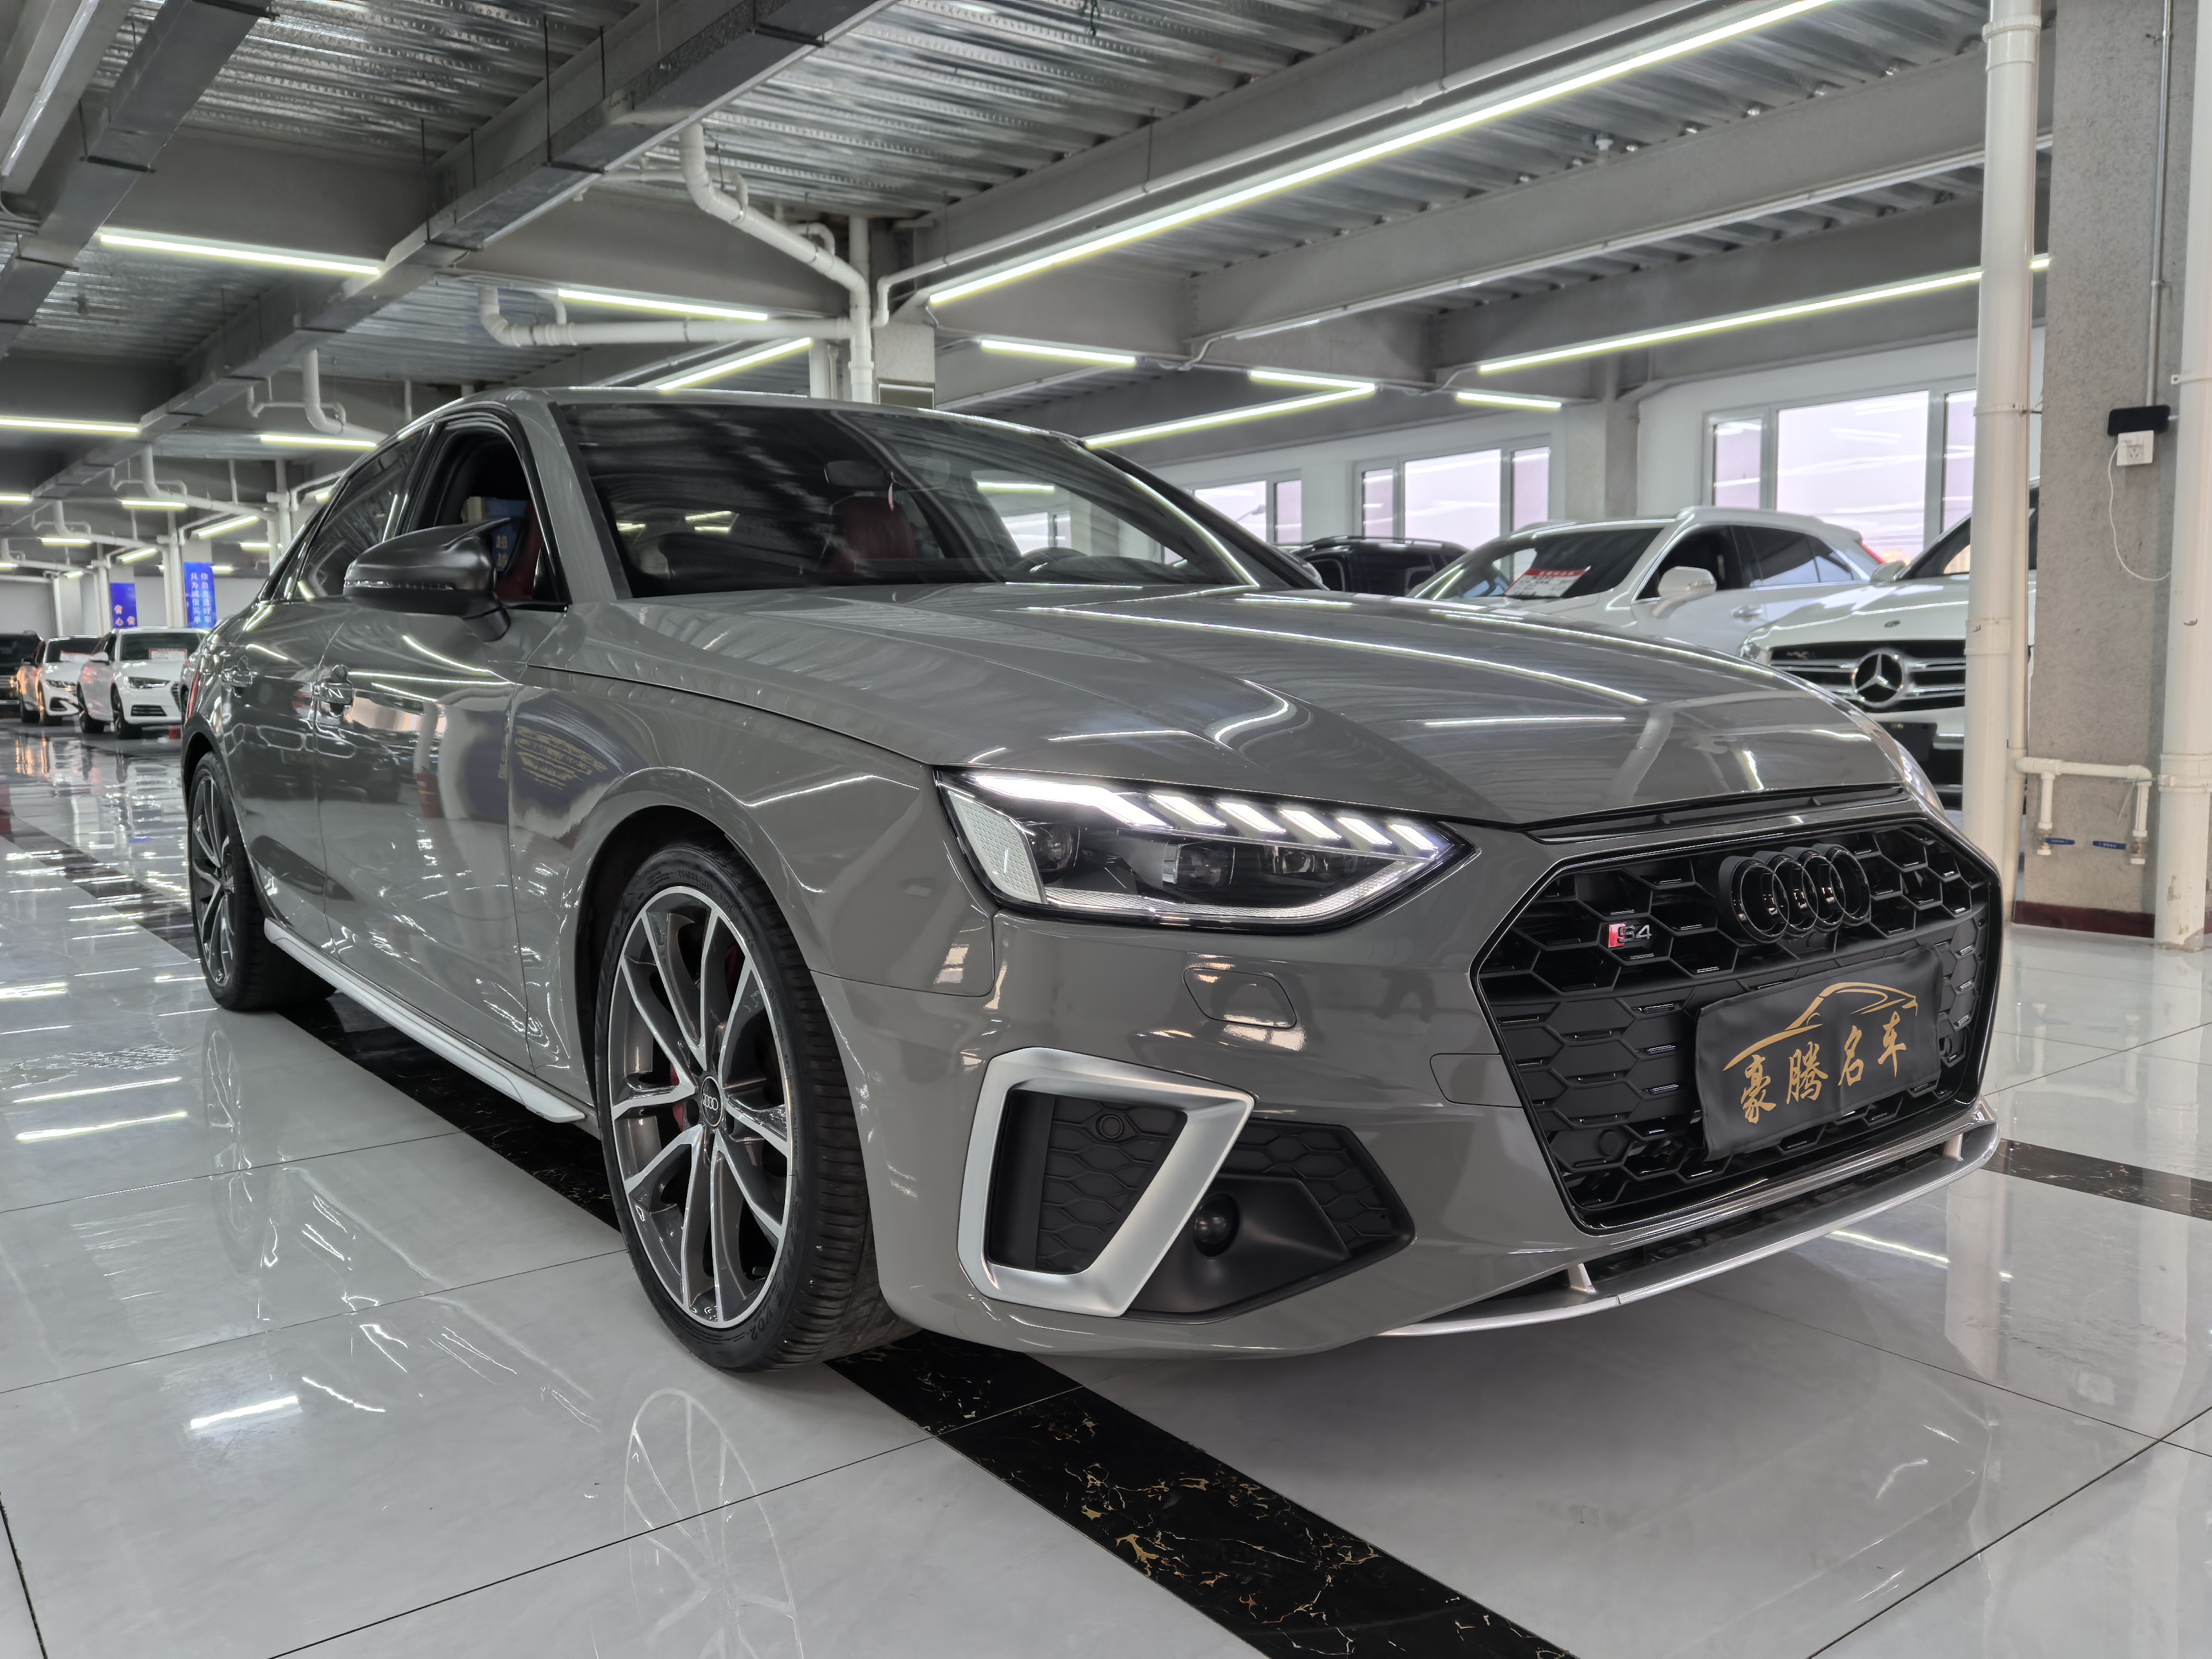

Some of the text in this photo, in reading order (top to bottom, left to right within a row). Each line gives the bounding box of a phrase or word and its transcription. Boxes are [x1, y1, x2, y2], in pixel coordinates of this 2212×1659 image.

[1618, 925, 1652, 943] S4
[1741, 1011, 1906, 1124] 豪腾名车
